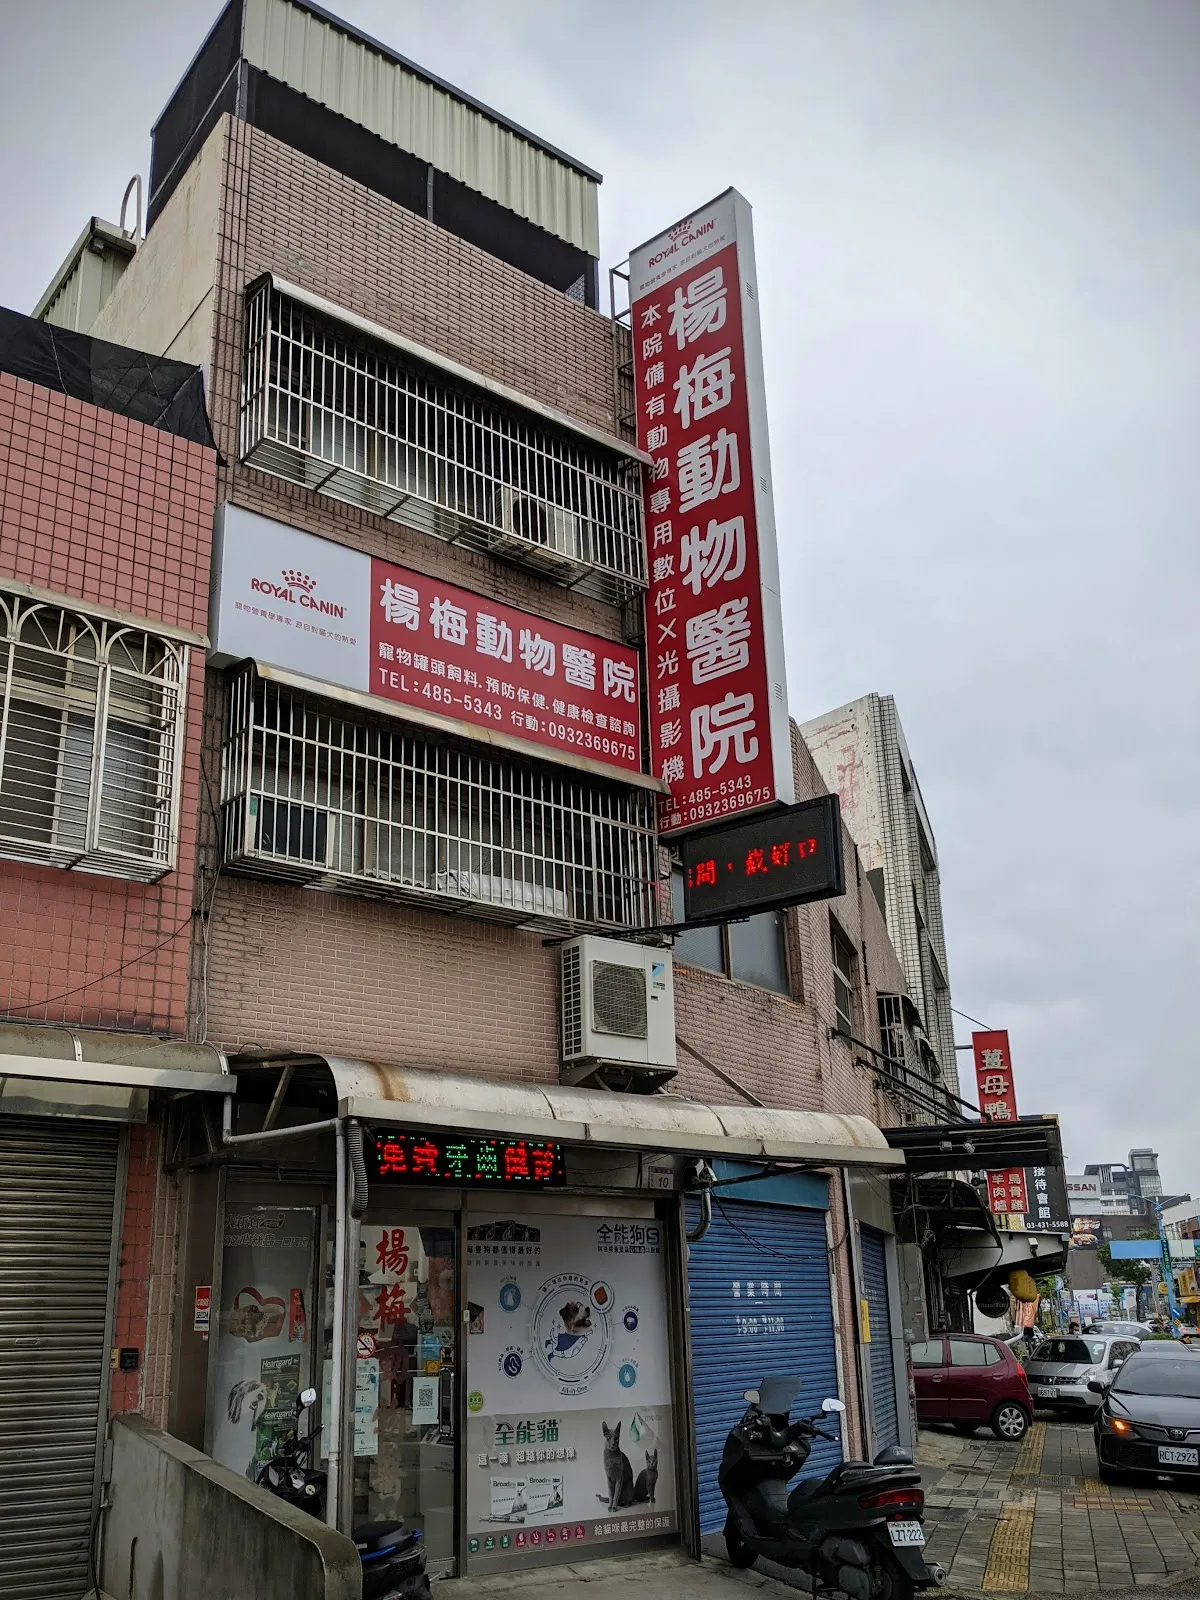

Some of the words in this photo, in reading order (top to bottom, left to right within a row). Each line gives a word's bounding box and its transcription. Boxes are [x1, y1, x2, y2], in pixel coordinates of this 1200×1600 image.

[648, 243, 680, 268] ROYAL
[681, 219, 715, 247] CANIN
[667, 266, 759, 780] 楊梅動物醫院
[251, 577, 296, 605] ROYAL
[299, 594, 345, 620] CANIN
[379, 578, 636, 703] 楊梅動物醫院
[979, 1049, 1011, 1121] 薑母鴨
[1033, 1166, 1051, 1219] 接待會館
[1065, 1183, 1097, 1192] SSAN
[1026, 1220, 1069, 1229] 03-431-5588
[372, 1228, 411, 1333] 楊梅
[262, 1357, 293, 1370] Heartgard
[495, 1419, 559, 1446] 全能貓
[1159, 1450, 1198, 1463] RCT-2923
[890, 1529, 924, 1542] LZ7-222
